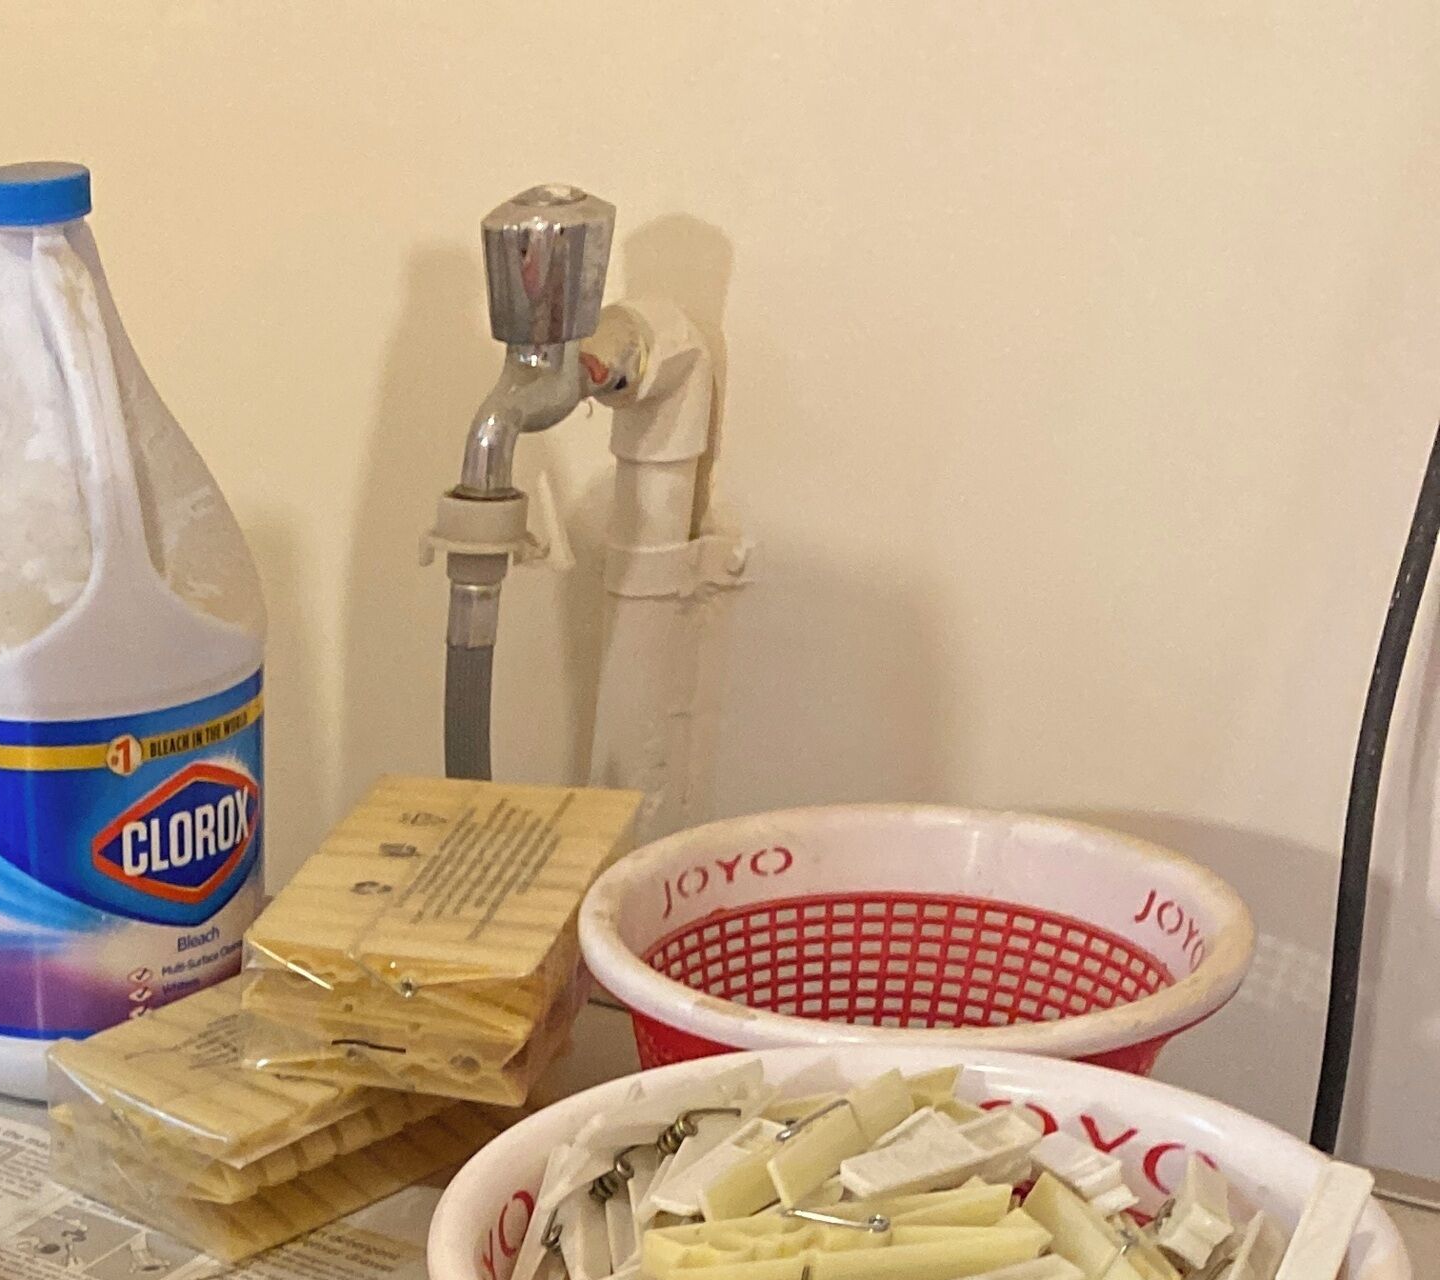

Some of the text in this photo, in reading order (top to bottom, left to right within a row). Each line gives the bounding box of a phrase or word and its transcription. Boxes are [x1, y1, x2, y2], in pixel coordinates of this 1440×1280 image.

[150, 734, 189, 758] BLEACH
[192, 730, 203, 746] IN
[120, 785, 252, 877] CLOROX
[662, 846, 793, 919] JOYO
[177, 925, 220, 952] Bleach
[1134, 889, 1206, 974] JOYO
